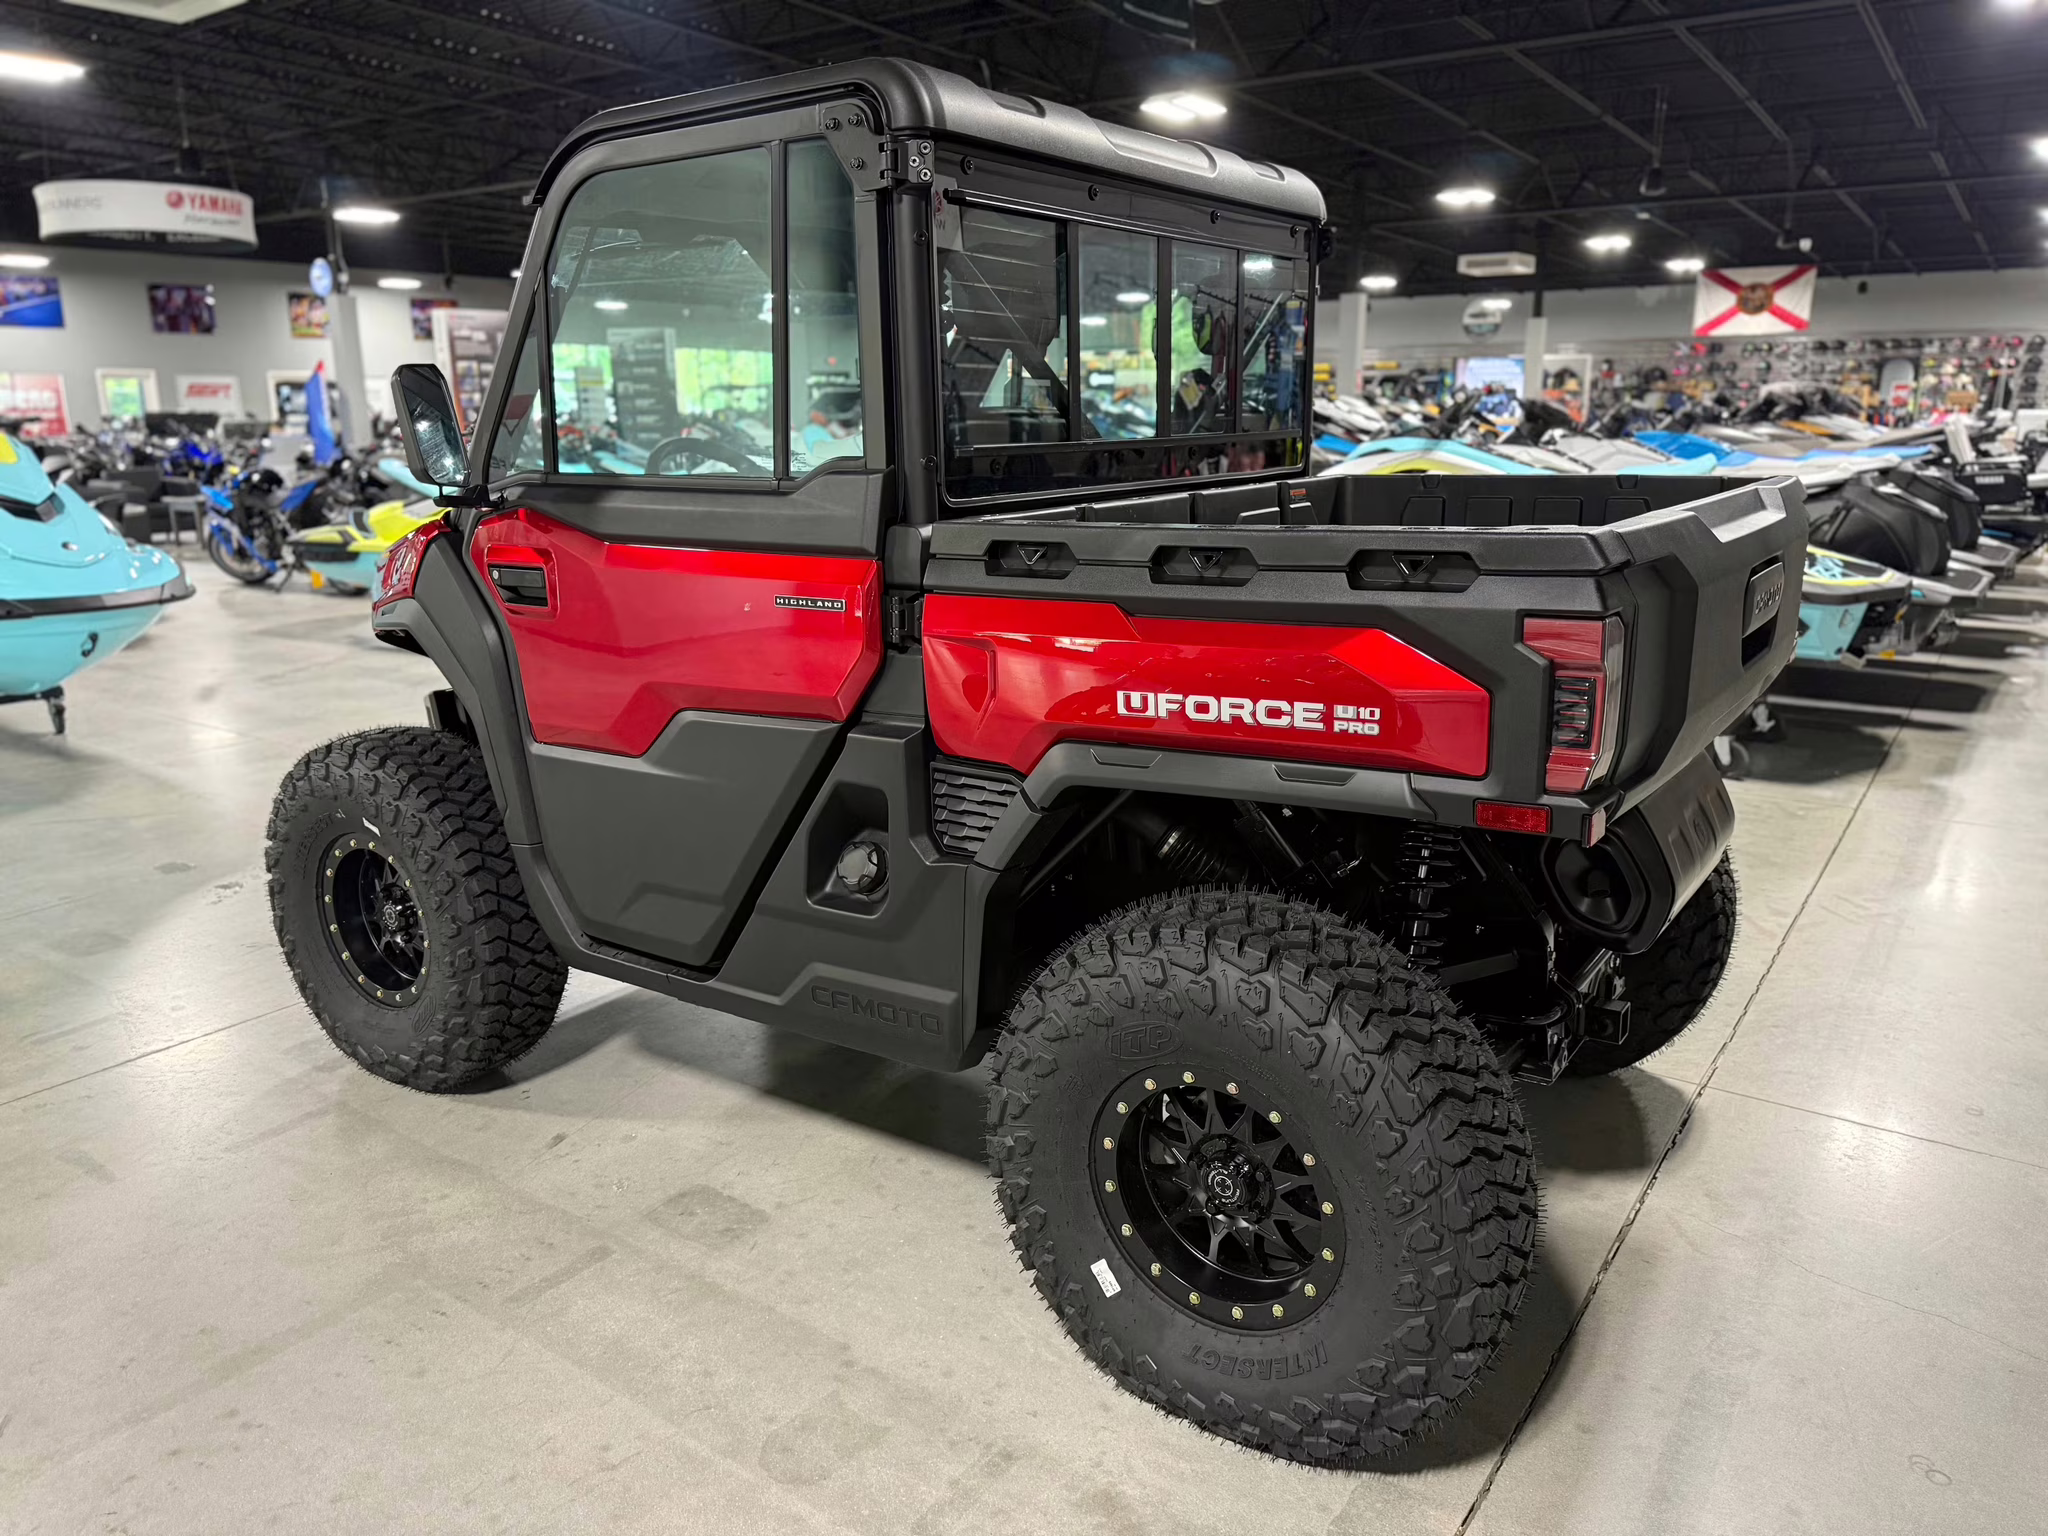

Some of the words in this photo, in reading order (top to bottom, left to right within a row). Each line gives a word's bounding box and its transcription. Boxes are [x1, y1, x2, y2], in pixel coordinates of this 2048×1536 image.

[776, 598, 841, 608] HIGHLAND
[1333, 704, 1381, 720] U10
[1333, 720, 1381, 736] PRO
[811, 984, 942, 1037] CFMOTO
[1110, 1024, 1172, 1059] ITP
[1183, 1340, 1329, 1381] INTERSECT
